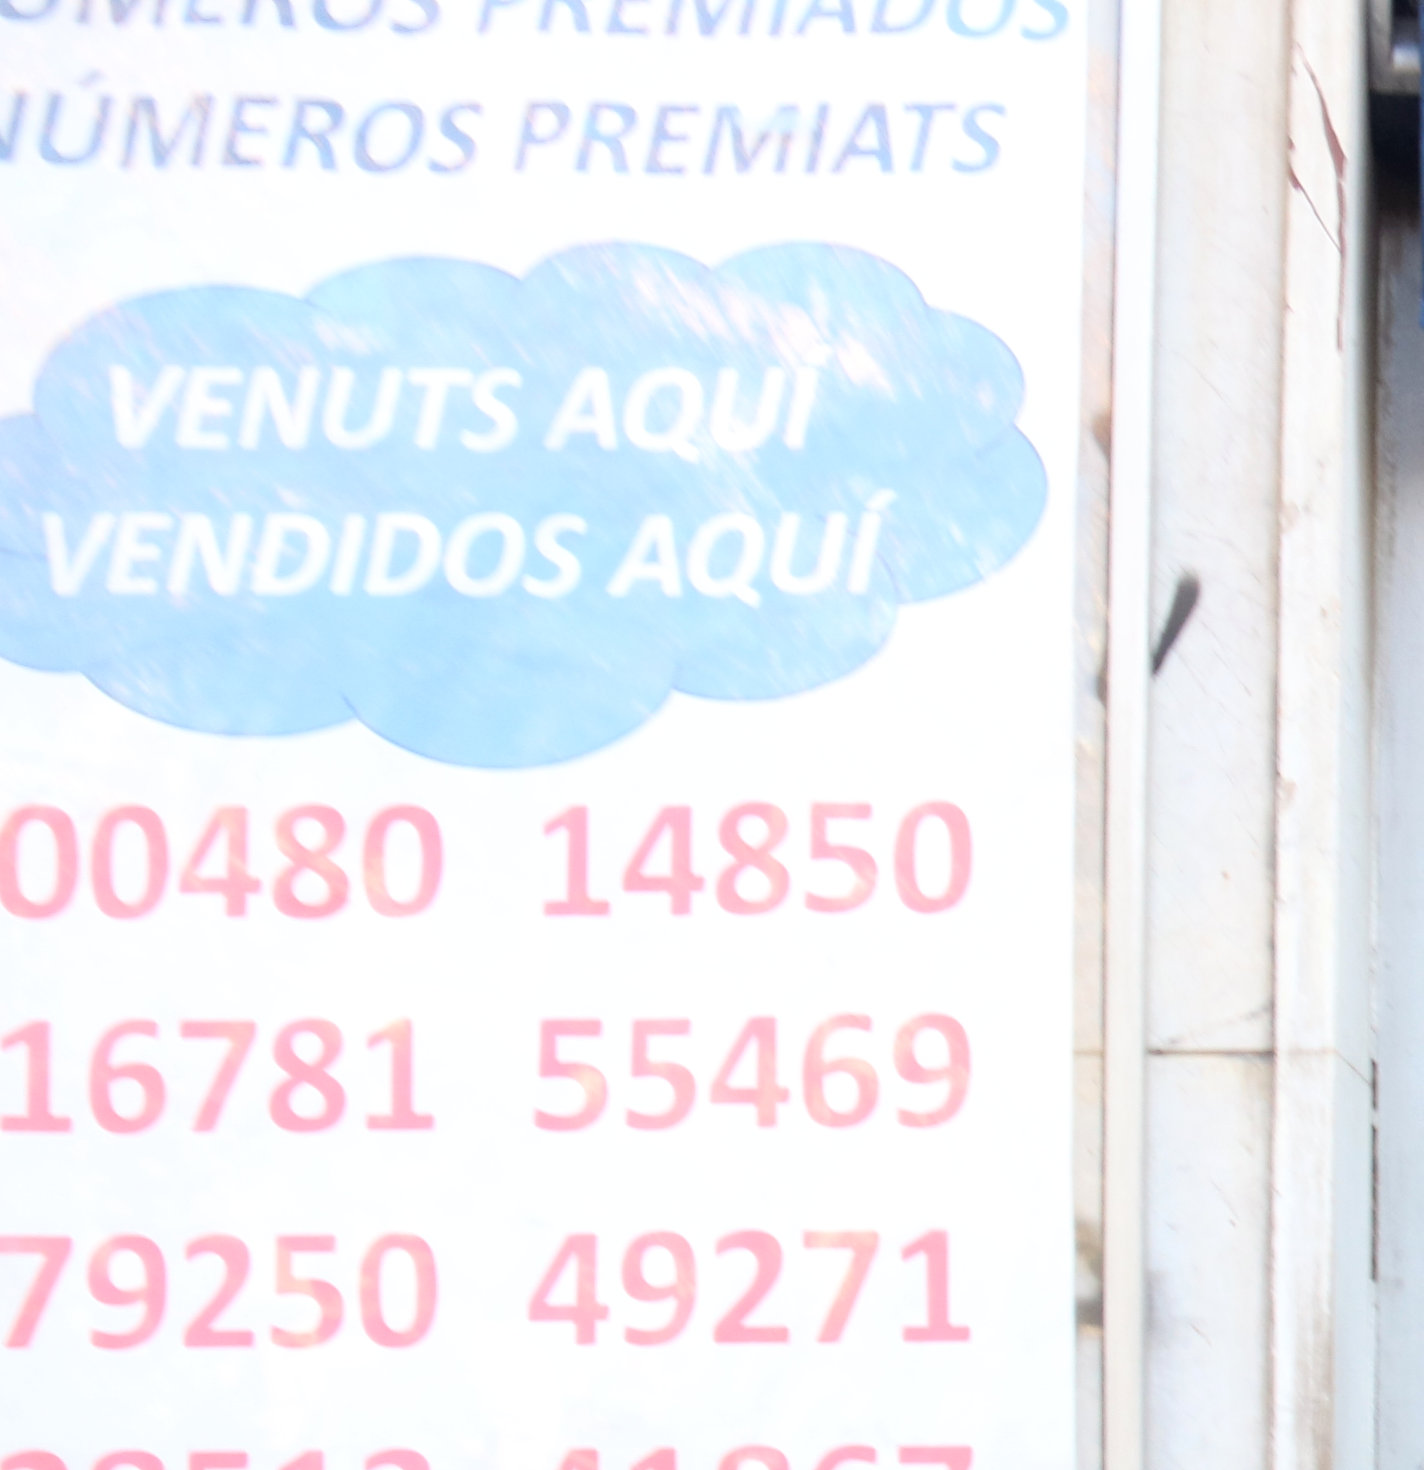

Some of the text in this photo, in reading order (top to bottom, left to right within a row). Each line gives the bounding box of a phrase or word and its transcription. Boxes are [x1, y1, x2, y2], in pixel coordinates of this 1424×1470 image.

[513, 101, 1008, 176] PREMIATS
[106, 342, 831, 462] VENUTS AQUÍ
[39, 486, 898, 608] VENDIDOS AQUÍ
[0, 800, 975, 922] 00480 14850
[0, 1011, 973, 1135] 16781 55469
[0, 1227, 971, 1351] 79250 49271
